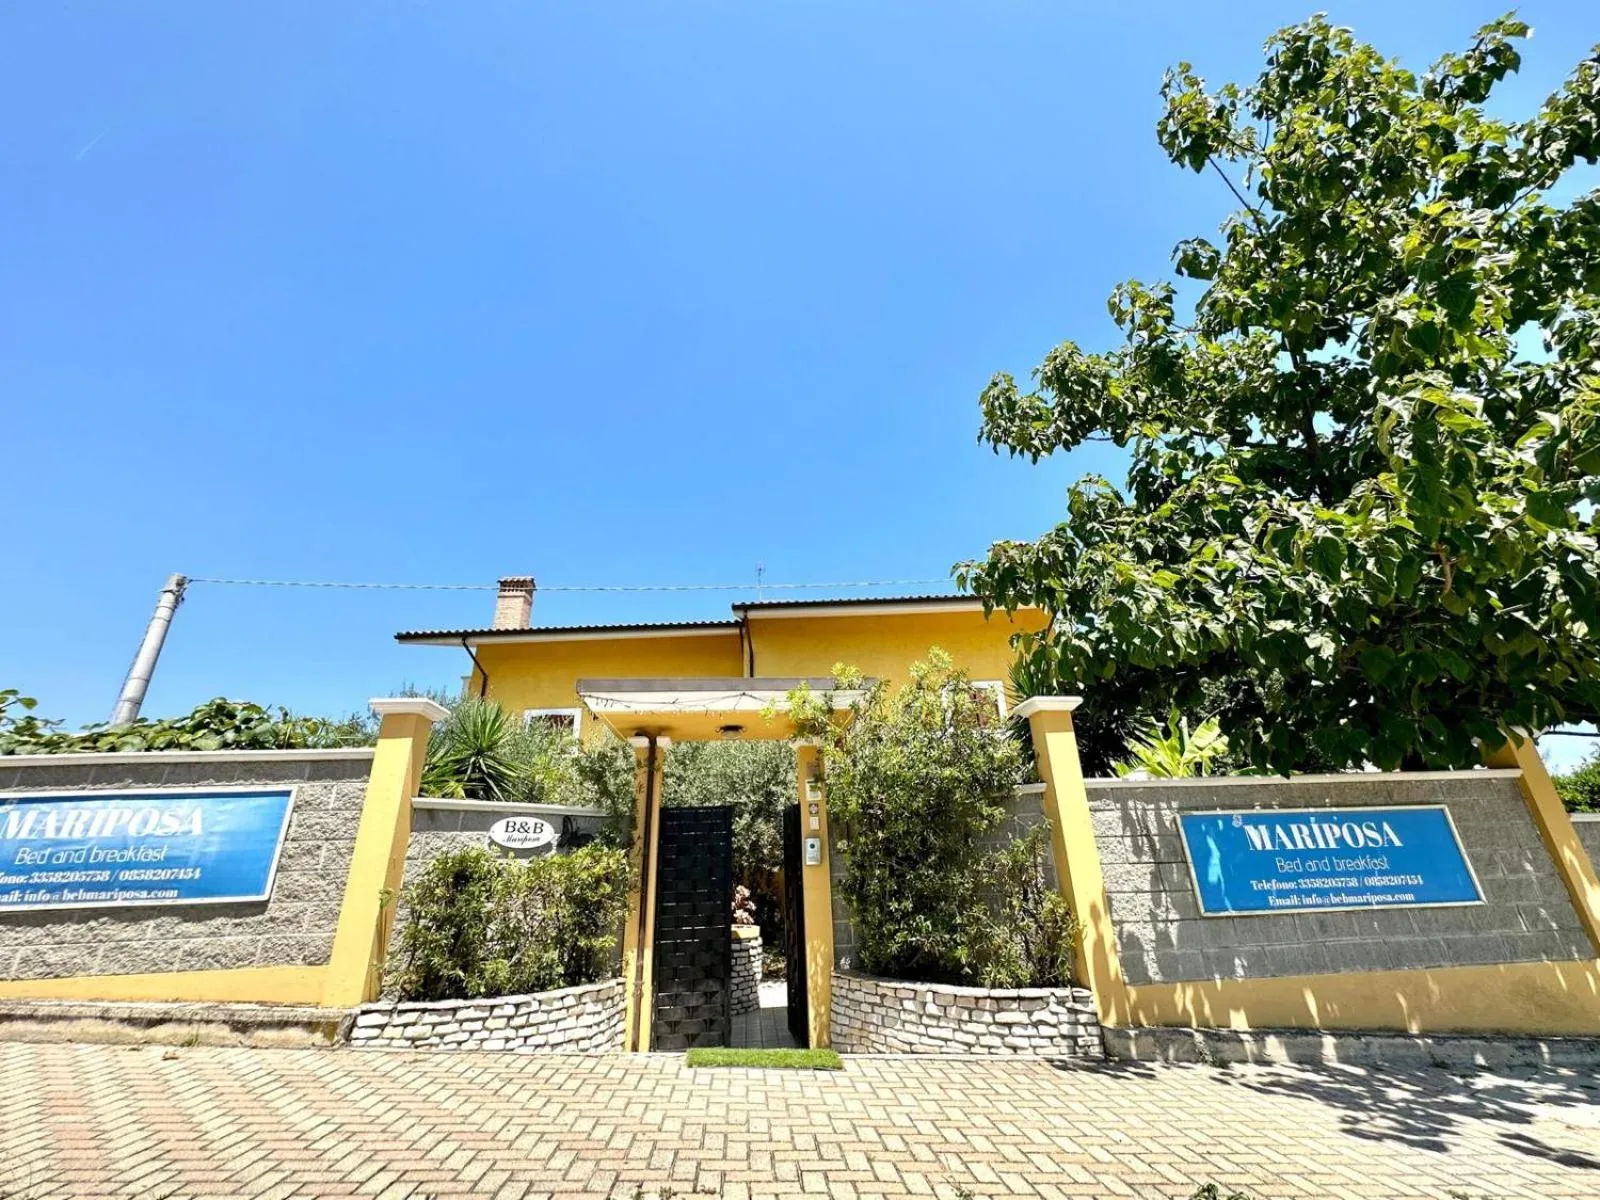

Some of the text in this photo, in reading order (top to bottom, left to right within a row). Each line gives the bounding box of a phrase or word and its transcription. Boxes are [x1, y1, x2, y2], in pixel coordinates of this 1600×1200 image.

[0, 807, 203, 840] MARIPOSA
[505, 820, 544, 834] B&B
[1243, 821, 1404, 851] MARIPOSA
[14, 846, 168, 865] Bed and breakfast
[1276, 854, 1390, 873] Bed and breakfast
[110, 868, 120, 882] /
[1250, 879, 1298, 891] Telefono:
[1268, 894, 1301, 906] Email:
